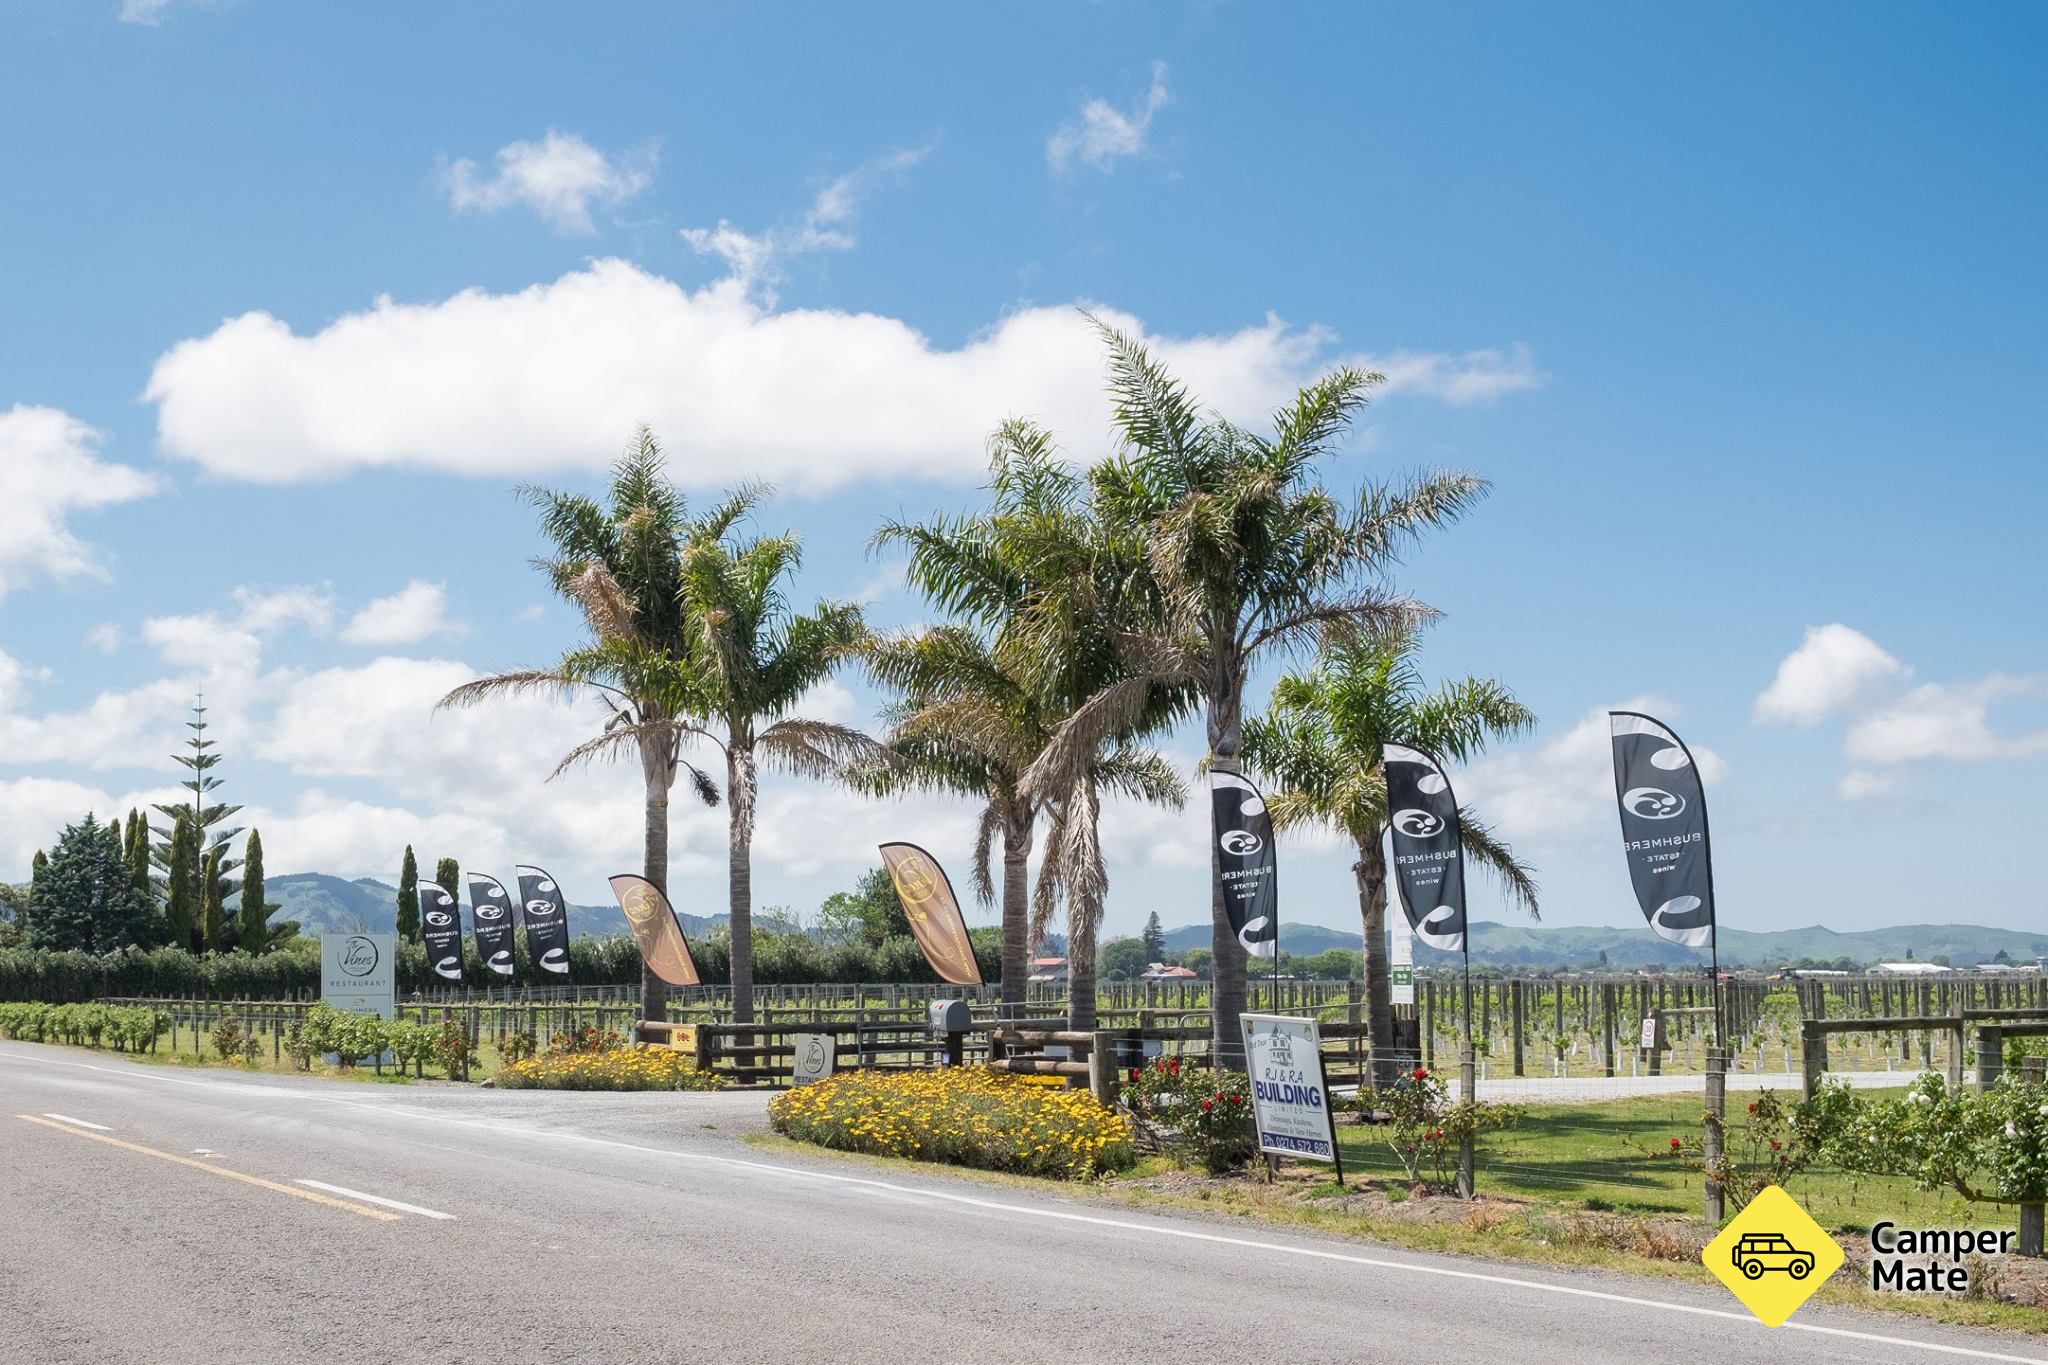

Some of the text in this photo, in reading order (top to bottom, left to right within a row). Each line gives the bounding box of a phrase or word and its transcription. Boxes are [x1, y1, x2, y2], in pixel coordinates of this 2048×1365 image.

[1280, 1070, 1286, 1082] &
[1256, 1080, 1322, 1107] BUILDING
[1297, 1140, 1313, 1153] 572
